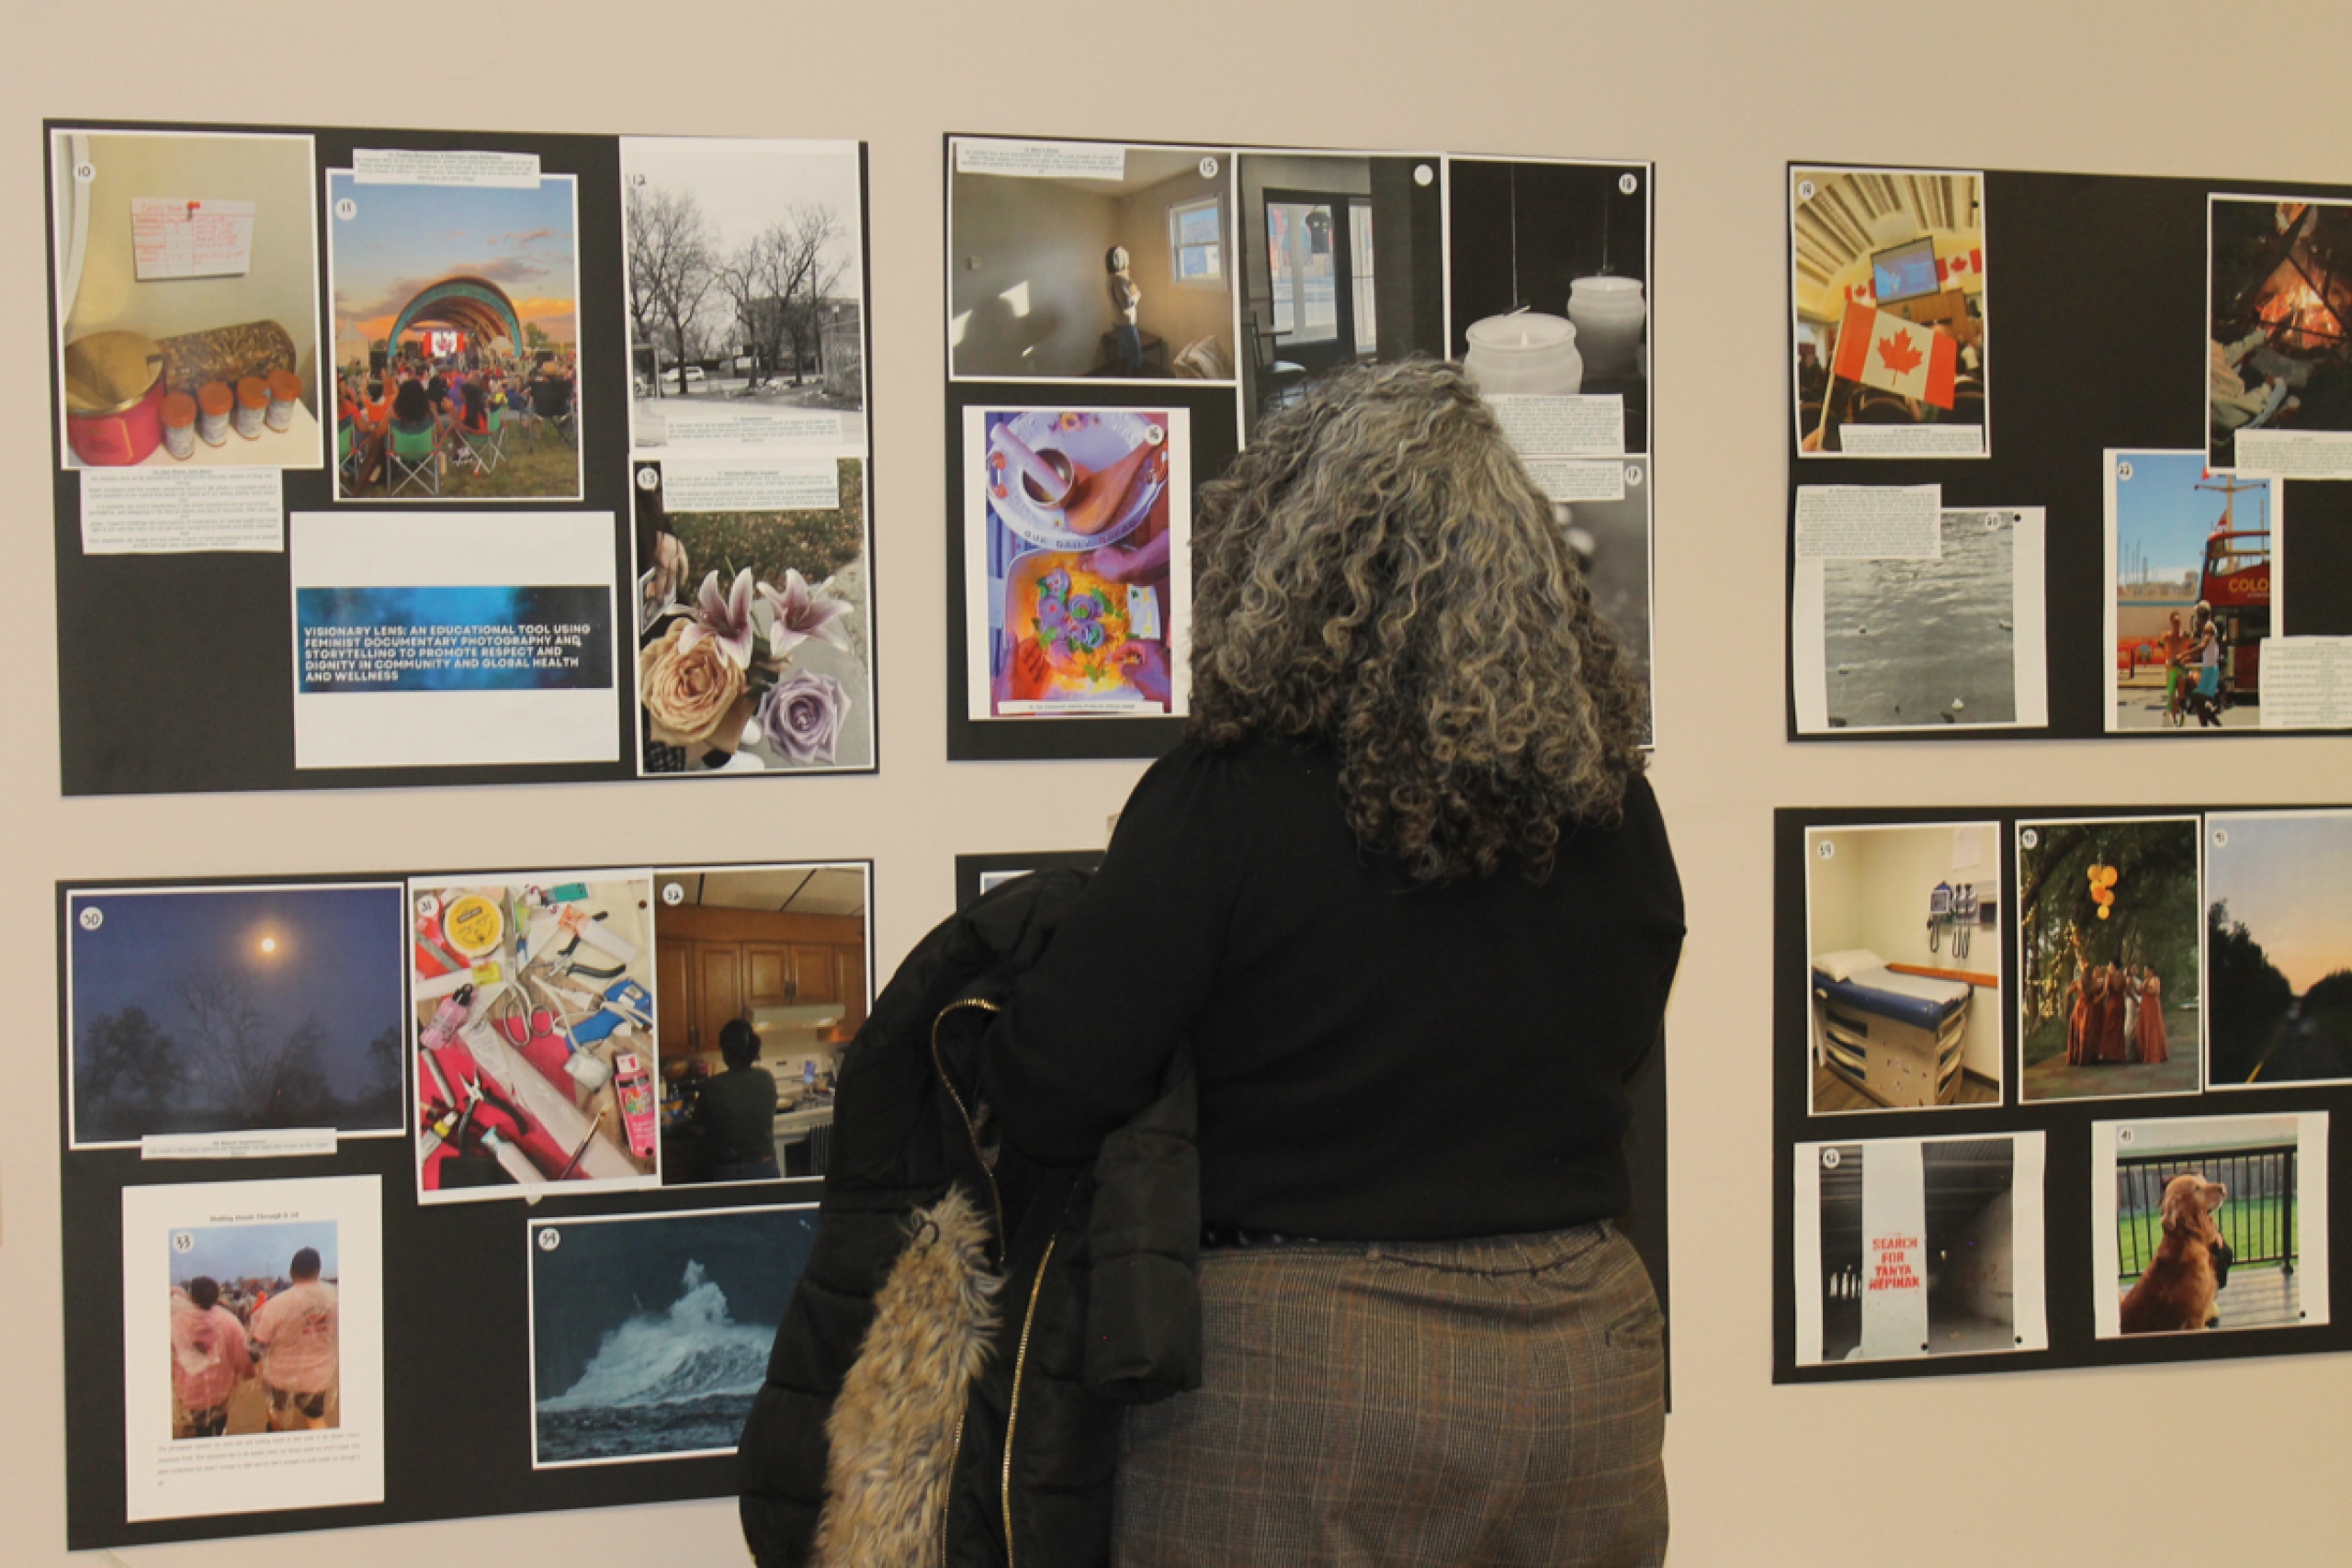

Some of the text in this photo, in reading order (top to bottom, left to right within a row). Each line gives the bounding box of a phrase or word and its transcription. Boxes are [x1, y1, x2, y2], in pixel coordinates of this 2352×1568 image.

[77, 166, 91, 176] 10
[304, 624, 591, 637] VISIONARY LENS: AN EDUCATIONAL TOOL USING
[305, 637, 362, 648] FEMINIST
[365, 636, 458, 648] DOCUMENTARY
[460, 635, 551, 646] PHOTOGRAPHY
[305, 646, 563, 660] STORYTELLING TO PROMOTE RESPECT AND
[305, 657, 579, 671] DIGNITY IN COMMUNITY AND GLOBAL HEALTH
[305, 671, 399, 682] AND WELLNESS
[1871, 1236, 1917, 1250] SEARCH
[1881, 1251, 1905, 1263] FOR
[1875, 1264, 1911, 1277] TANYA
